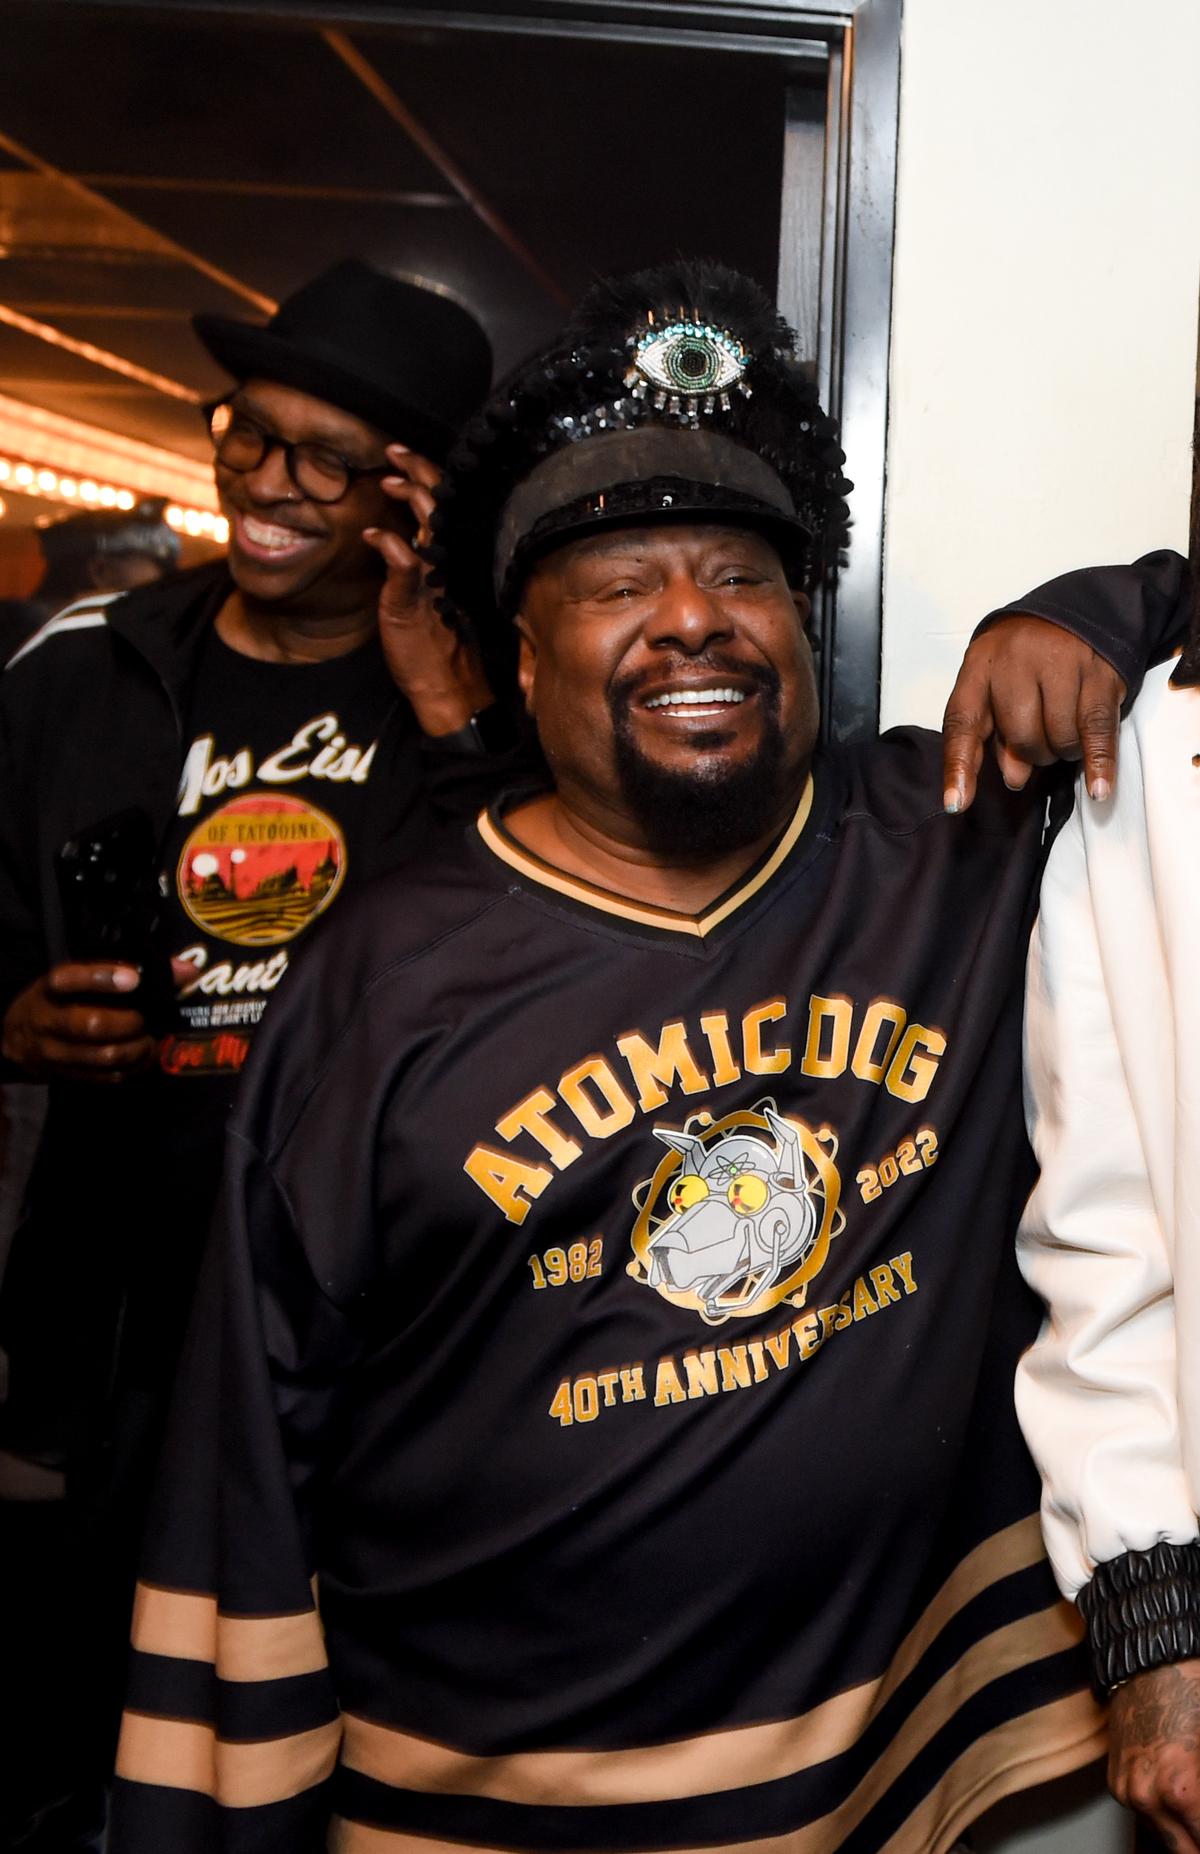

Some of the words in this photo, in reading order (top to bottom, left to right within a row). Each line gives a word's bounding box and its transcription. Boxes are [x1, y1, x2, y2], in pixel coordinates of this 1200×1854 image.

[463, 1001, 792, 1226] ATOMIC
[801, 994, 947, 1104] DOG
[856, 1129, 939, 1204] 2022
[527, 1239, 603, 1290] 1982
[549, 1367, 646, 1427] 40TH
[654, 1252, 918, 1407] ANNIVERSARY
